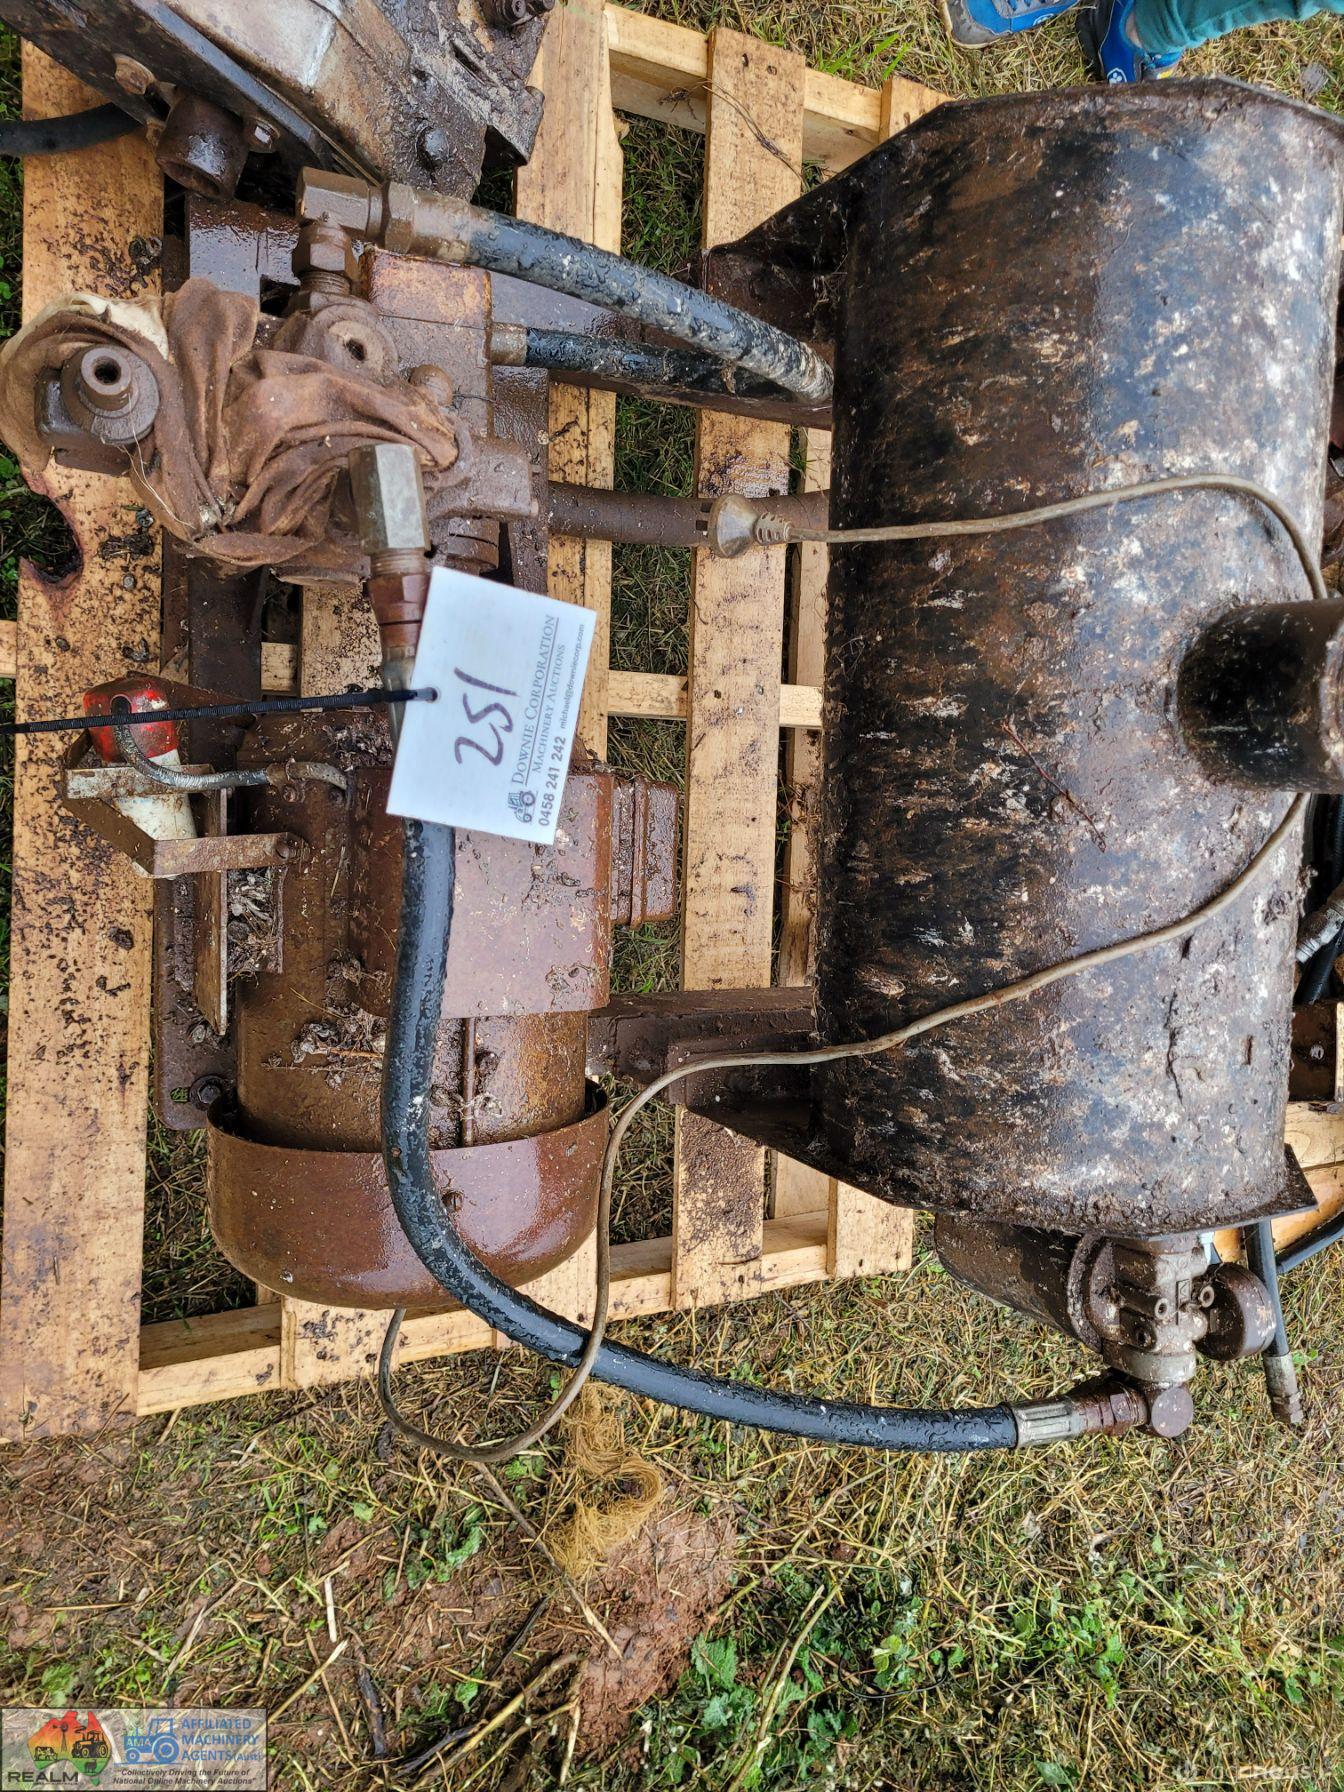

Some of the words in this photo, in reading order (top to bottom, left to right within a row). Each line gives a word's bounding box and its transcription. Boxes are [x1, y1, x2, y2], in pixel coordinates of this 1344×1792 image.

[453, 666, 521, 766] 251
[511, 724, 535, 784] DOWNIE
[524, 614, 555, 720] CORPORATION
[532, 704, 555, 773] MACHINERY
[546, 644, 566, 703] AUCTIONS
[560, 623, 585, 729] michael@downiecorp.com
[545, 767, 560, 790] 241
[551, 736, 566, 762] 242
[538, 793, 556, 826] 0458
